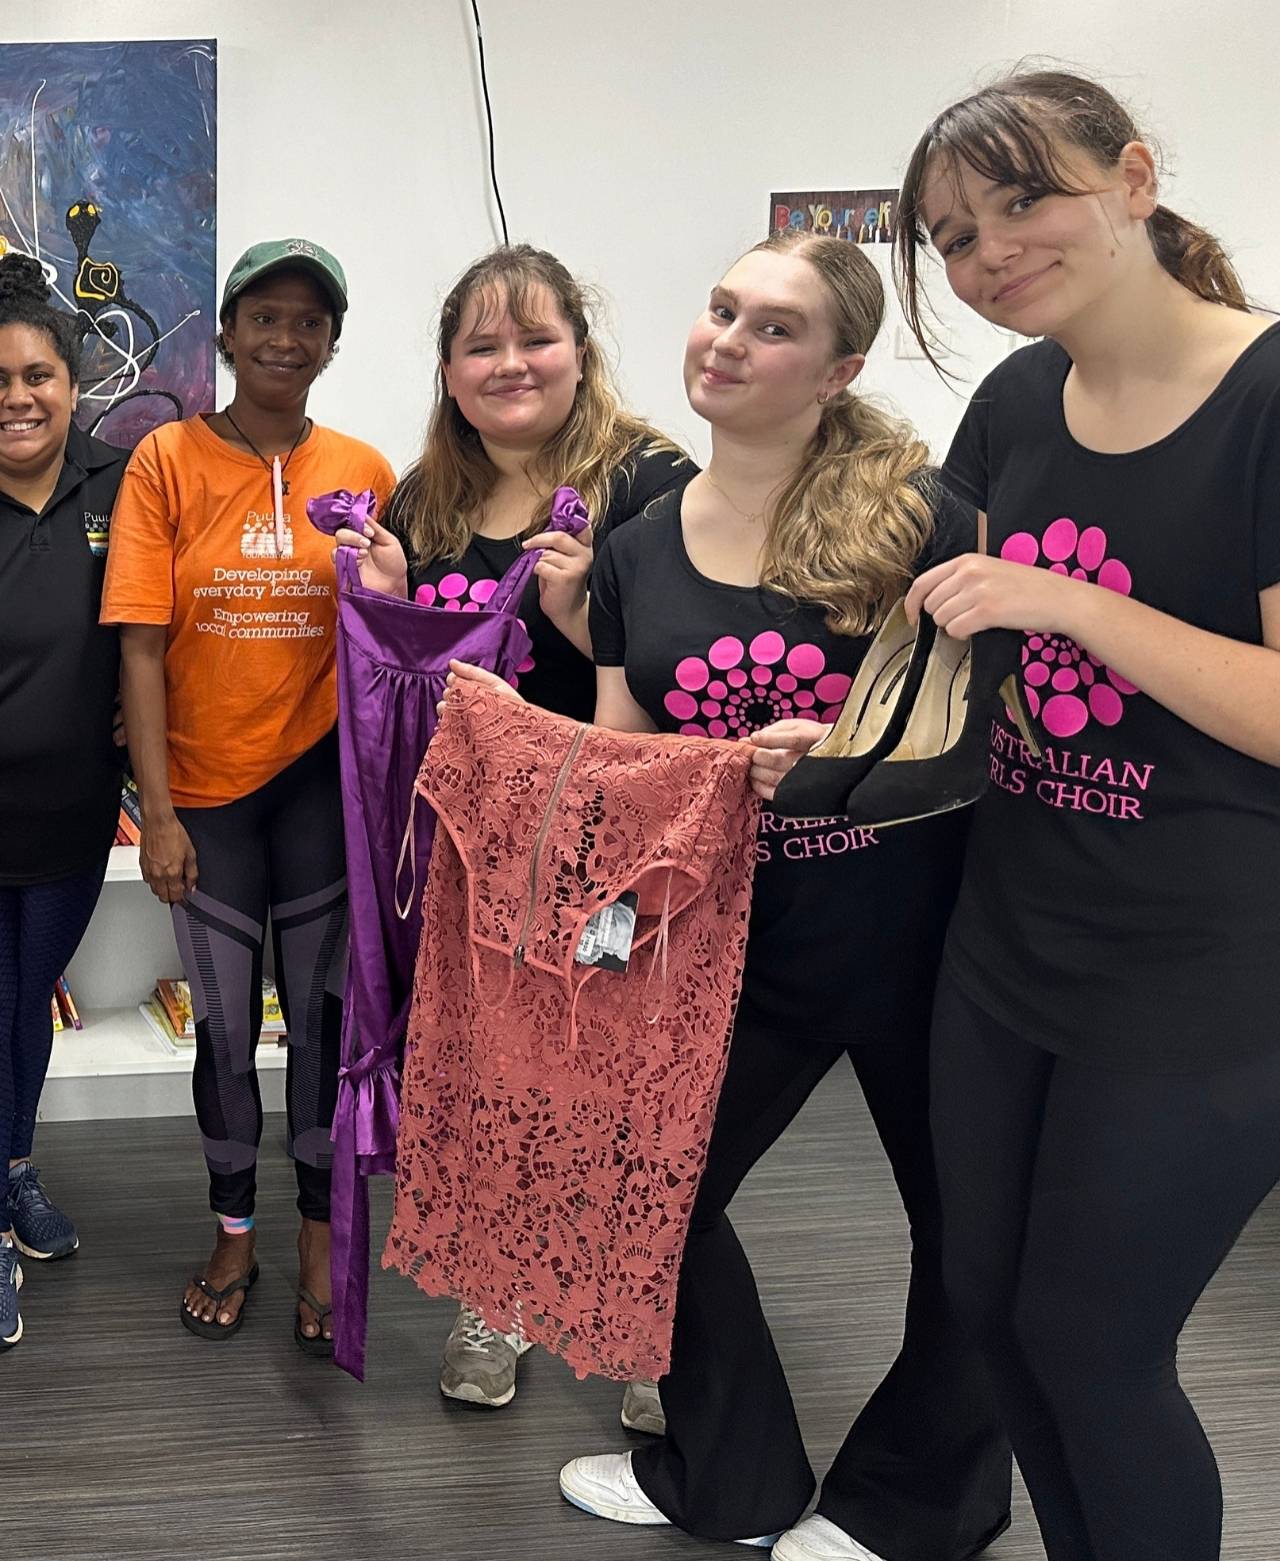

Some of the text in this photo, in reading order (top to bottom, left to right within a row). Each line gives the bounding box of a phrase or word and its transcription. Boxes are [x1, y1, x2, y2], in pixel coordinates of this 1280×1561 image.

[775, 204, 805, 230] Be
[246, 510, 291, 523] Puua
[213, 567, 313, 584] Developing
[193, 581, 330, 599] everyday leaders
[213, 608, 310, 626] Empowering
[195, 622, 325, 640] local communities
[990, 719, 1155, 791] USTRALIAN
[990, 753, 1144, 820] RLS CHOIR
[783, 827, 879, 860] CHOIR
